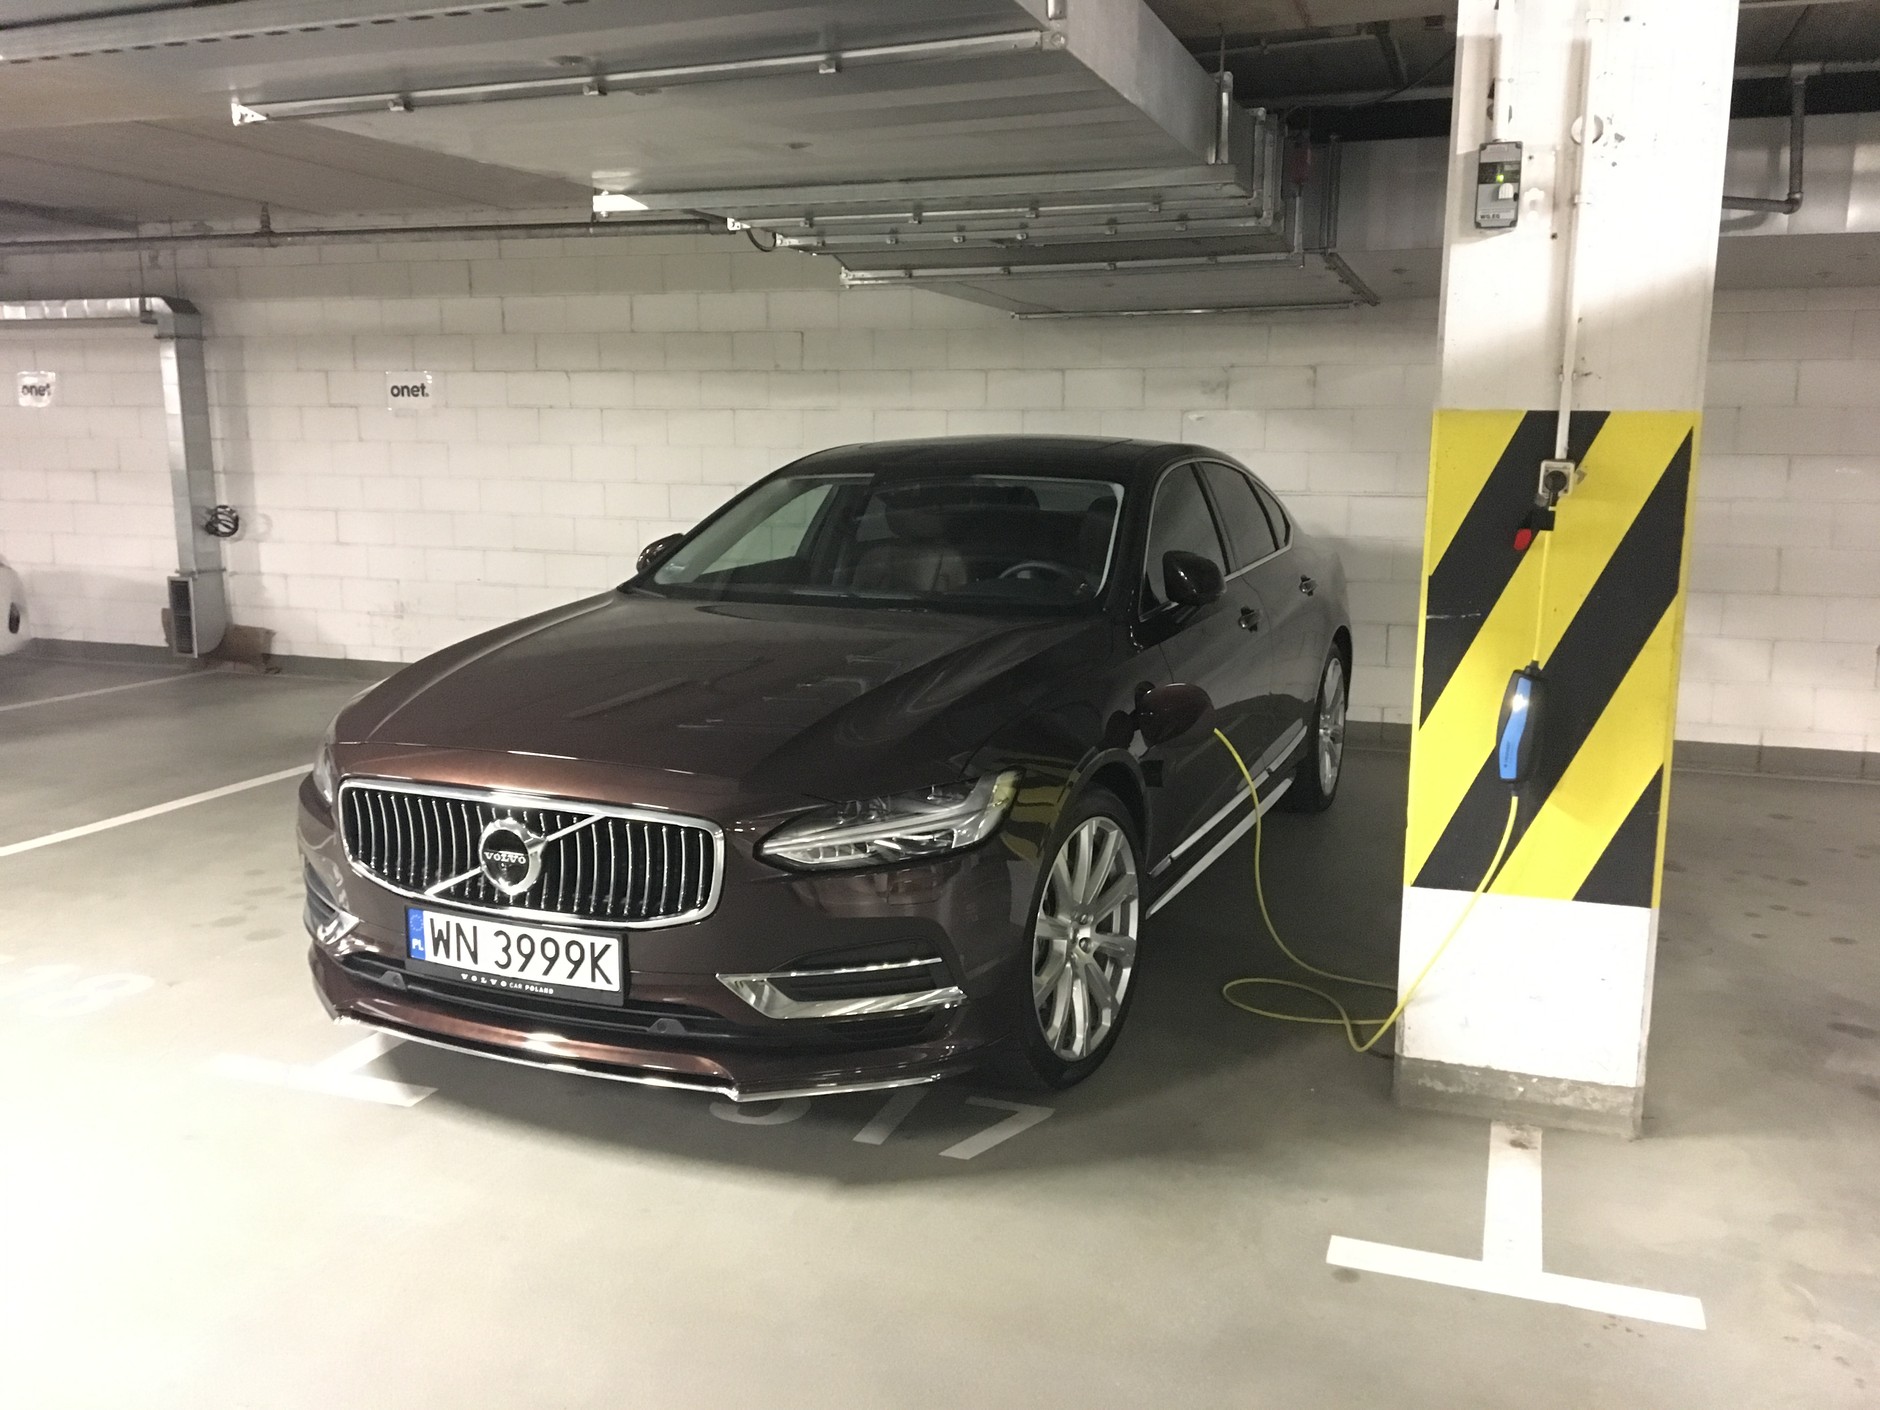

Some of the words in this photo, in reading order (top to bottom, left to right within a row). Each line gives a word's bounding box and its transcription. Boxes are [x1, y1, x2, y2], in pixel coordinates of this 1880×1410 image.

[483, 851, 527, 865] VOLVO
[412, 938, 425, 951] PL
[429, 917, 479, 966] WN
[493, 929, 614, 986] 3999K
[460, 973, 507, 988] VOLVO
[509, 981, 523, 991] CAR
